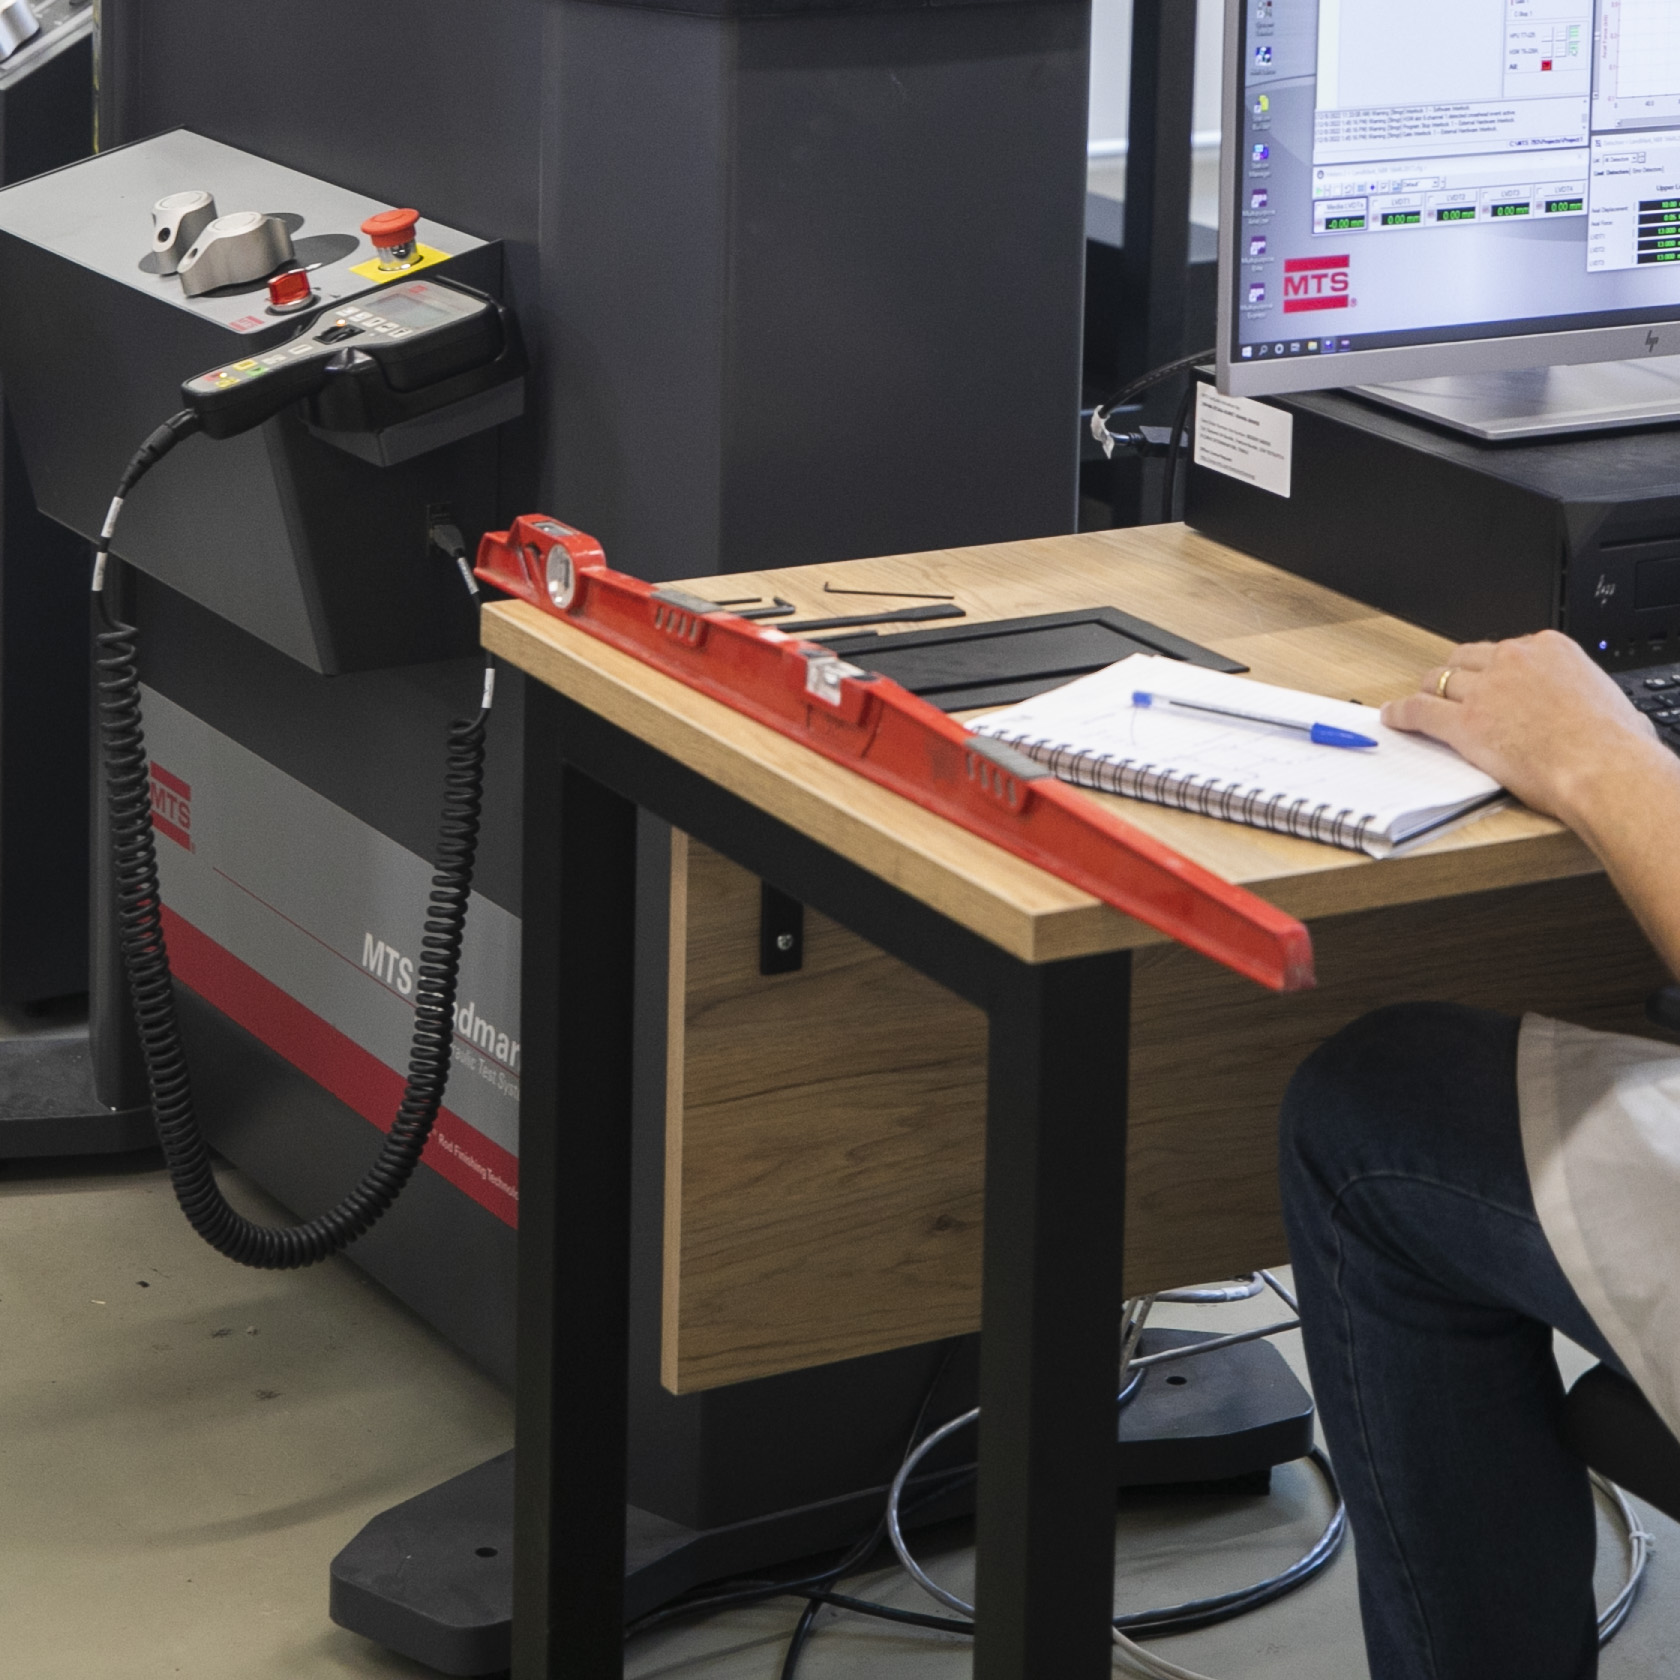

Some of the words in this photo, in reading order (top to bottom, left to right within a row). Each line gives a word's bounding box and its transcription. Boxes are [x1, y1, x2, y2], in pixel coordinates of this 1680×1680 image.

[1283, 272, 1350, 297] MTS
[361, 931, 413, 996] MTS
[477, 1057, 498, 1080] Test
